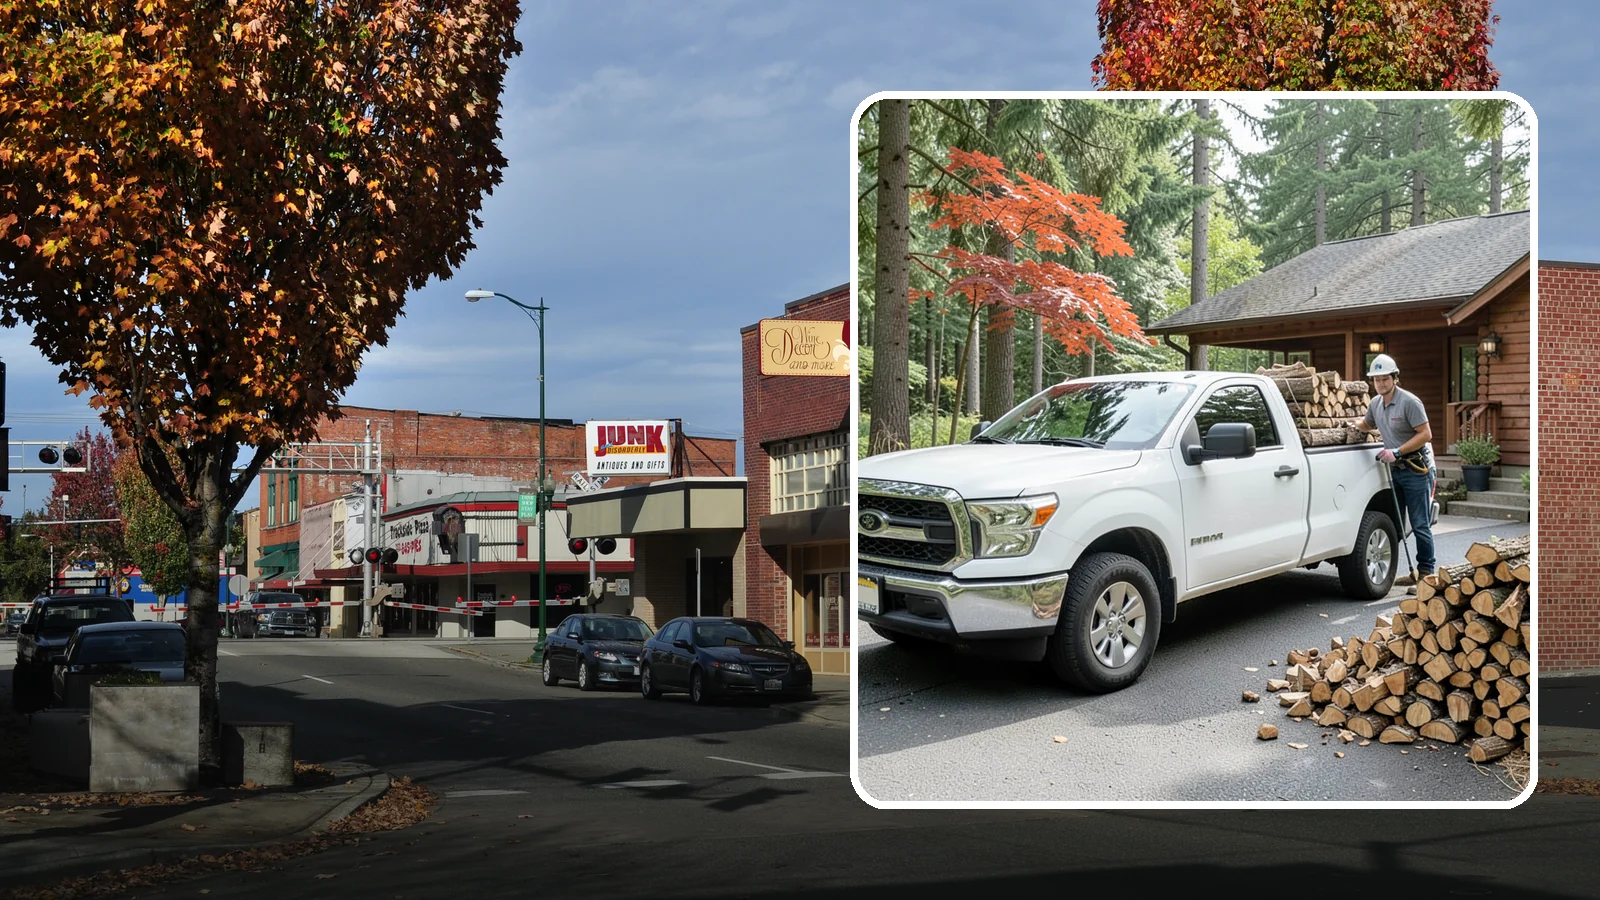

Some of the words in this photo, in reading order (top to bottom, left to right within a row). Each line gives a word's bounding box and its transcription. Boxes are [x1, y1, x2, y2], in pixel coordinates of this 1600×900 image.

[595, 425, 665, 457] JUNK
[607, 446, 646, 454] DISORDERLY
[597, 461, 628, 470] ANTIQUES
[631, 461, 644, 470] AND
[647, 460, 665, 470] GIFTS
[414, 519, 429, 535] Pizza
